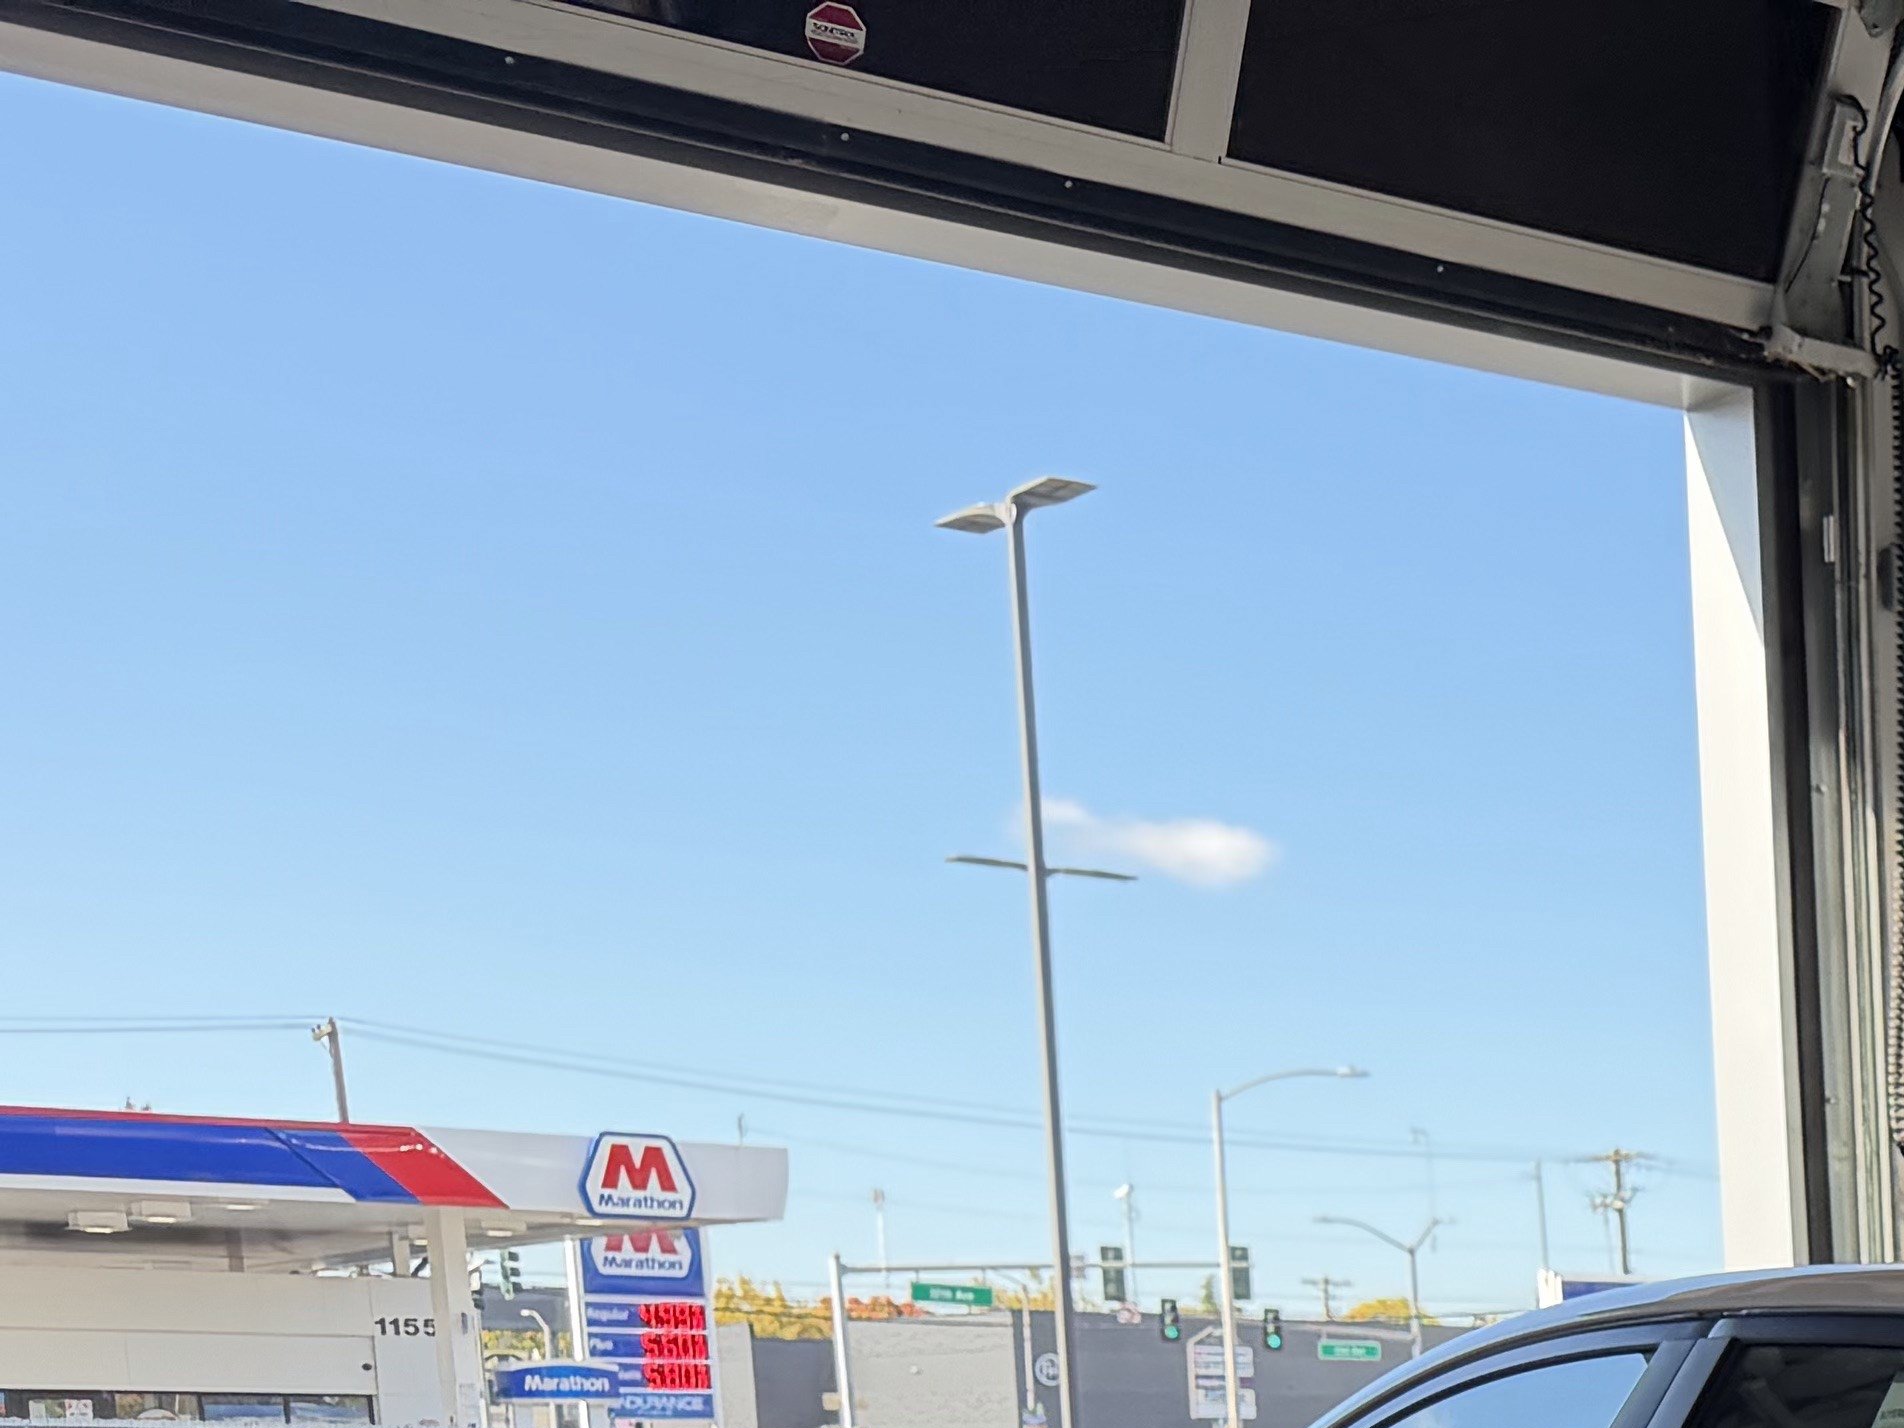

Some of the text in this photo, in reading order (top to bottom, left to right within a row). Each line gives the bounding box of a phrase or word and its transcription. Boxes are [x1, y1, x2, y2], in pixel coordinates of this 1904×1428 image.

[599, 1193, 683, 1210] Marathon
[603, 1255, 683, 1271] Marathon
[374, 1317, 436, 1337] 1155
[523, 1374, 610, 1393] Marathon
